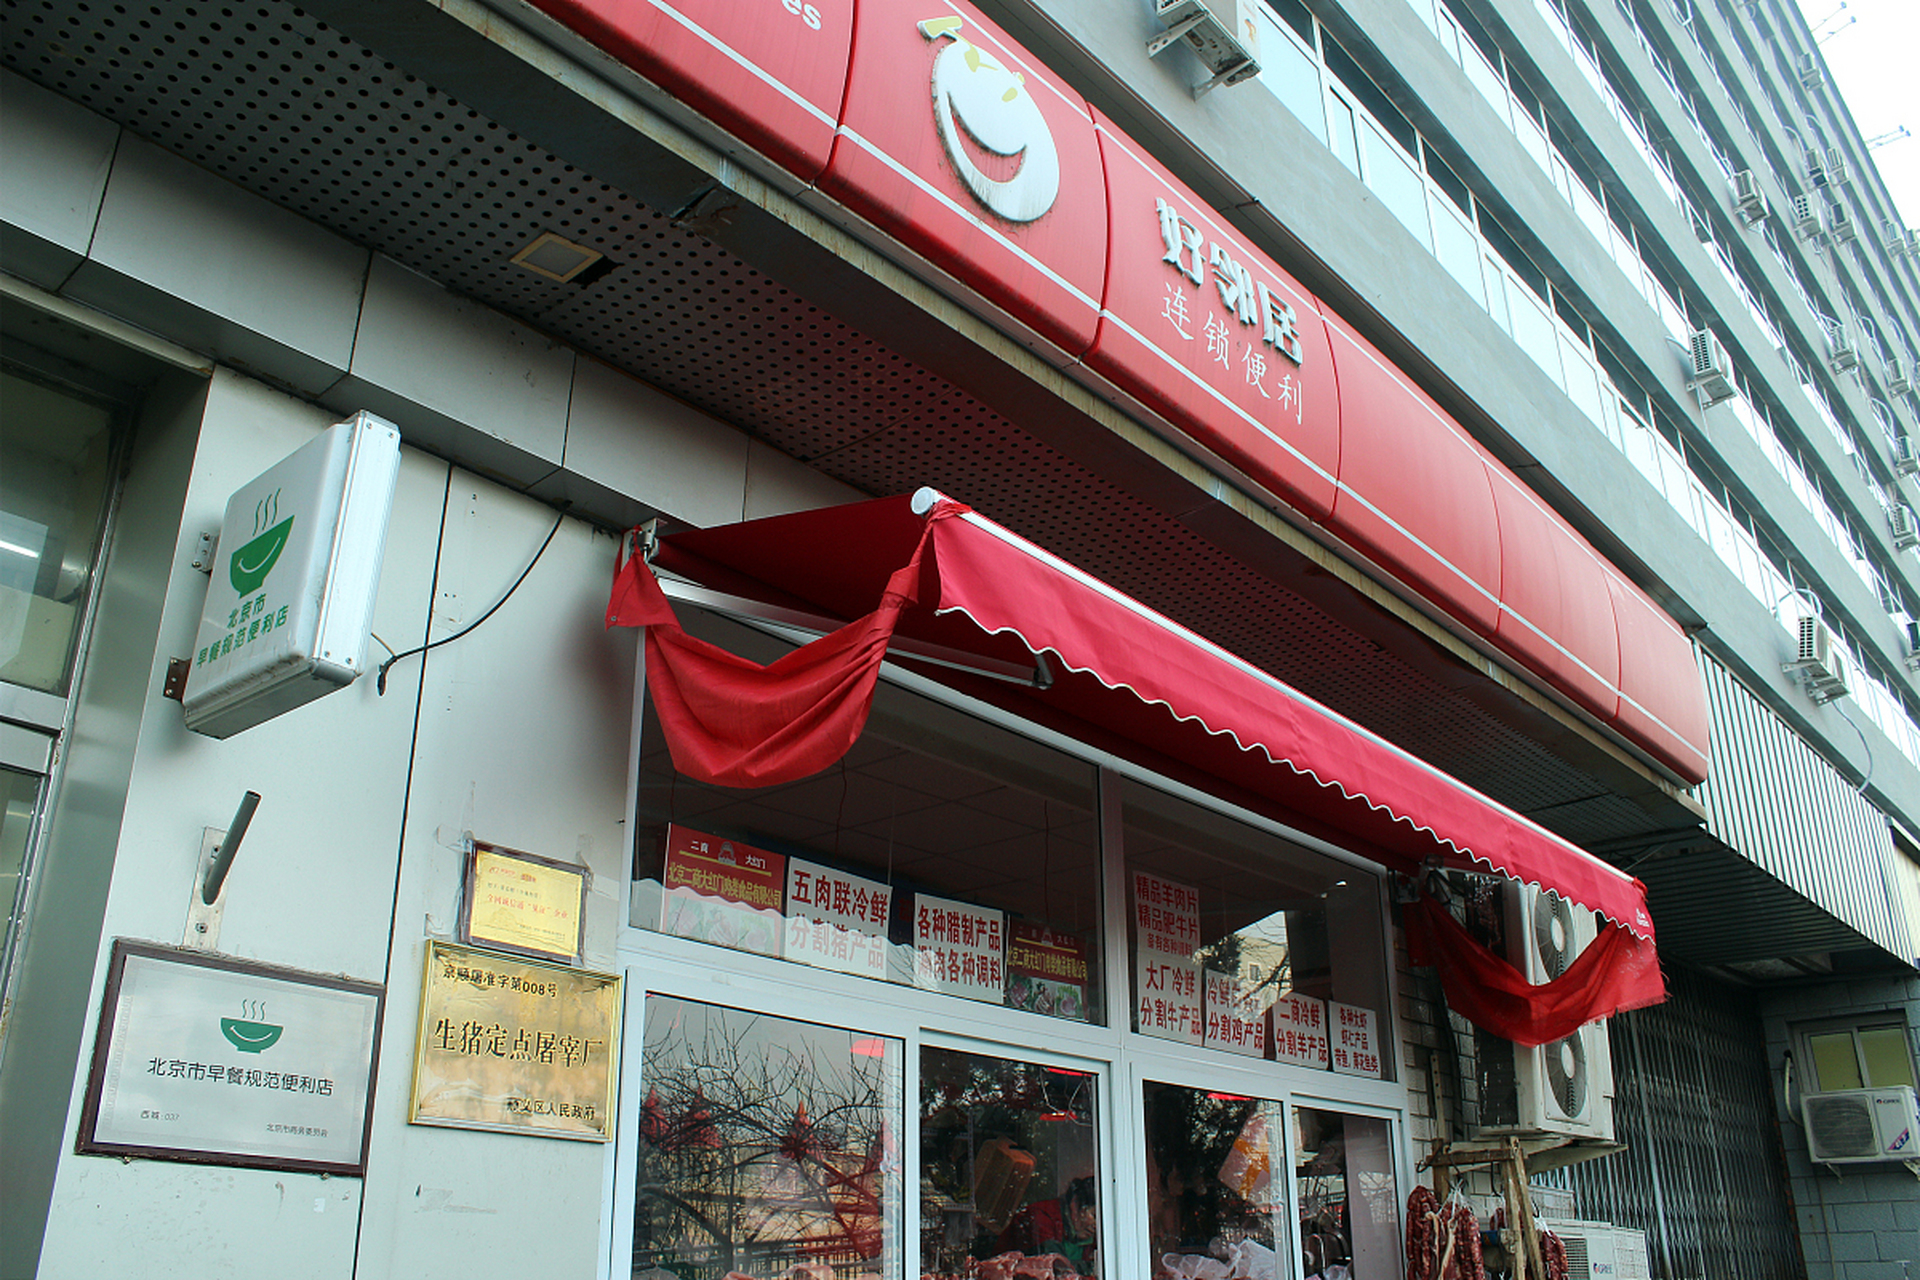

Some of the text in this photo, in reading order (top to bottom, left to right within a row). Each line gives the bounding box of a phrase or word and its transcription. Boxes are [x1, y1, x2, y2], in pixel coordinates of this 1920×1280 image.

[1155, 197, 1304, 366] 好邻居
[1160, 282, 1303, 426] 连锁便利
[226, 593, 267, 630] 北京市
[196, 604, 290, 669] 早餐规范便利店
[791, 869, 888, 928] 五肉联冷鲜
[1135, 874, 1199, 915] 精品羊肉片
[789, 913, 885, 971] 分割猪产品
[917, 904, 1001, 952] 各种腊制产品
[1137, 902, 1199, 942] 精品肥牛片
[1146, 959, 1196, 1000] 大厂冷鲜
[1140, 996, 1202, 1035] 分割牛产品
[1208, 1011, 1264, 1050] 分割鸡产品
[1280, 998, 1321, 1030] 二商冷鲜
[433, 1018, 603, 1067] 生猪定点屠宰厂
[1276, 1028, 1328, 1063] 分割羊产品
[147, 1056, 334, 1097] 北京市早餐规范便利店
